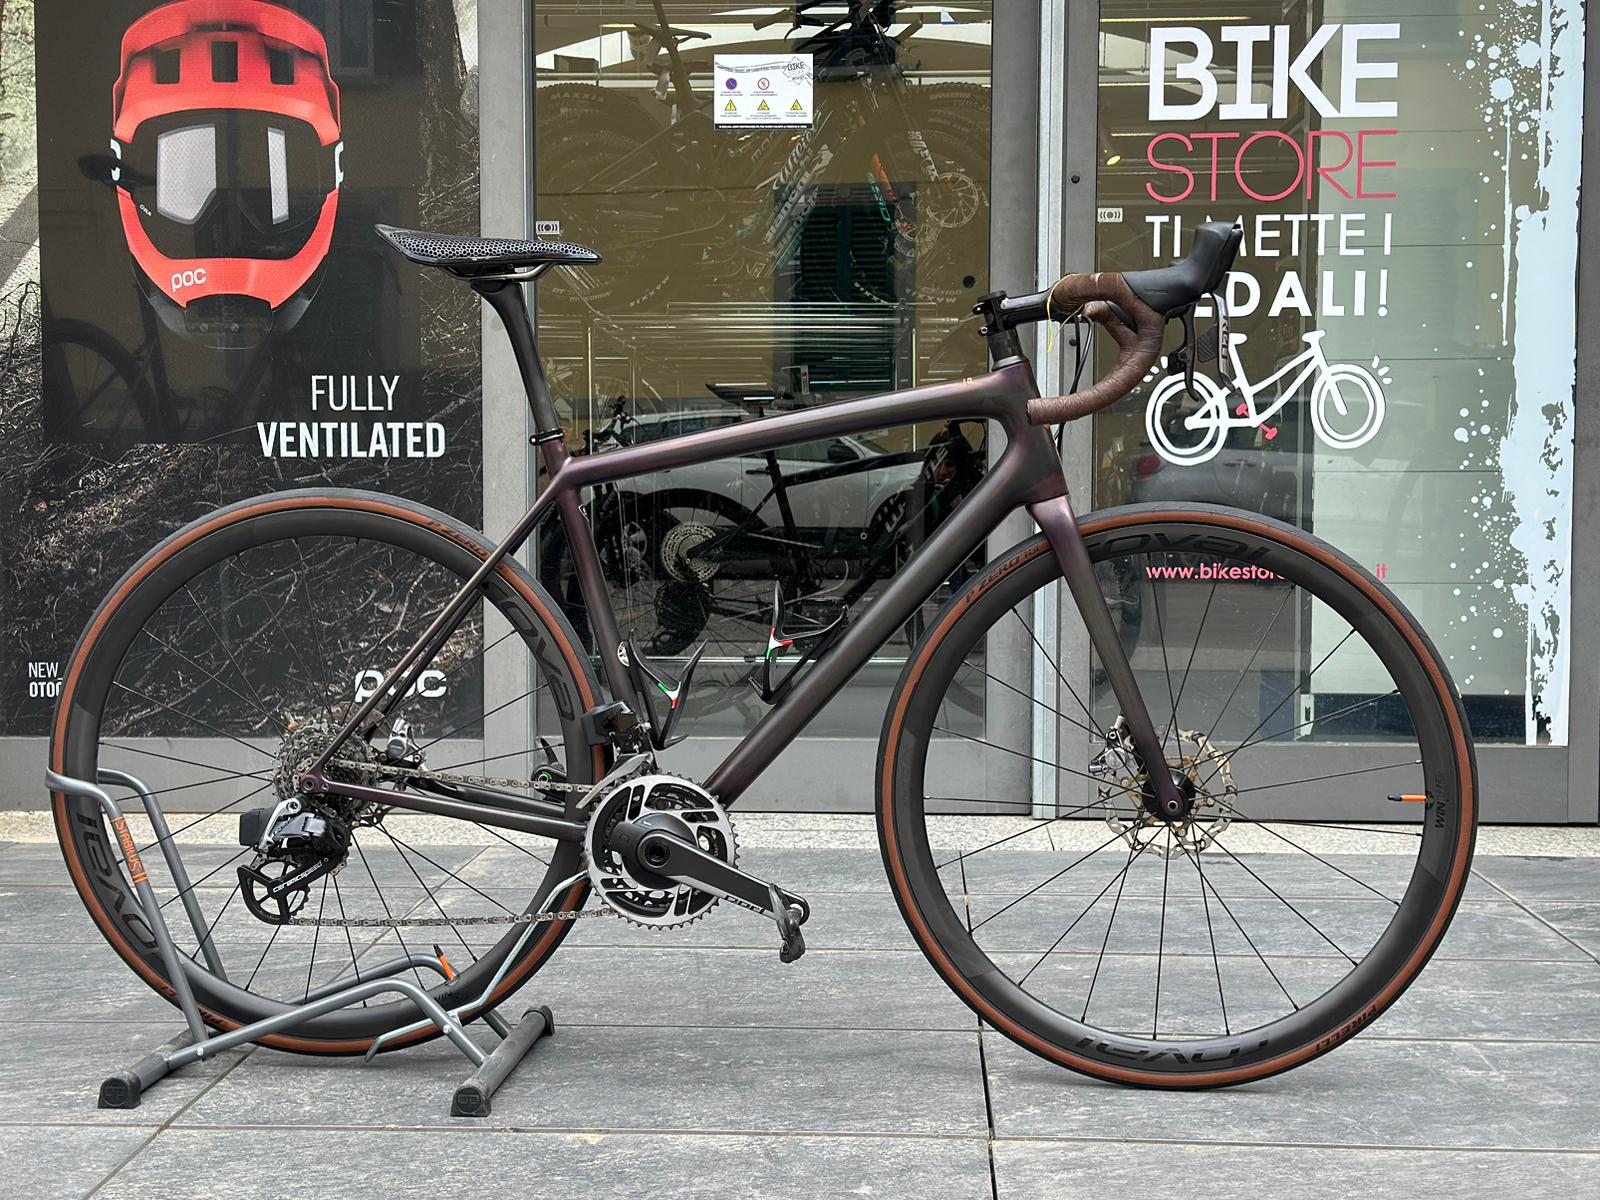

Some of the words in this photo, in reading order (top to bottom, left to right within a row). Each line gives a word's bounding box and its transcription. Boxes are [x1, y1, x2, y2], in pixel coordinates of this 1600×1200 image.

[1148, 23, 1400, 121] BIKE
[1146, 129, 1398, 203] STORE
[1145, 214, 1182, 258] TI
[1194, 269, 1388, 317] DALI!
[311, 375, 400, 411] FULLY
[257, 421, 446, 459] VENTILATED
[355, 669, 447, 703] pc
